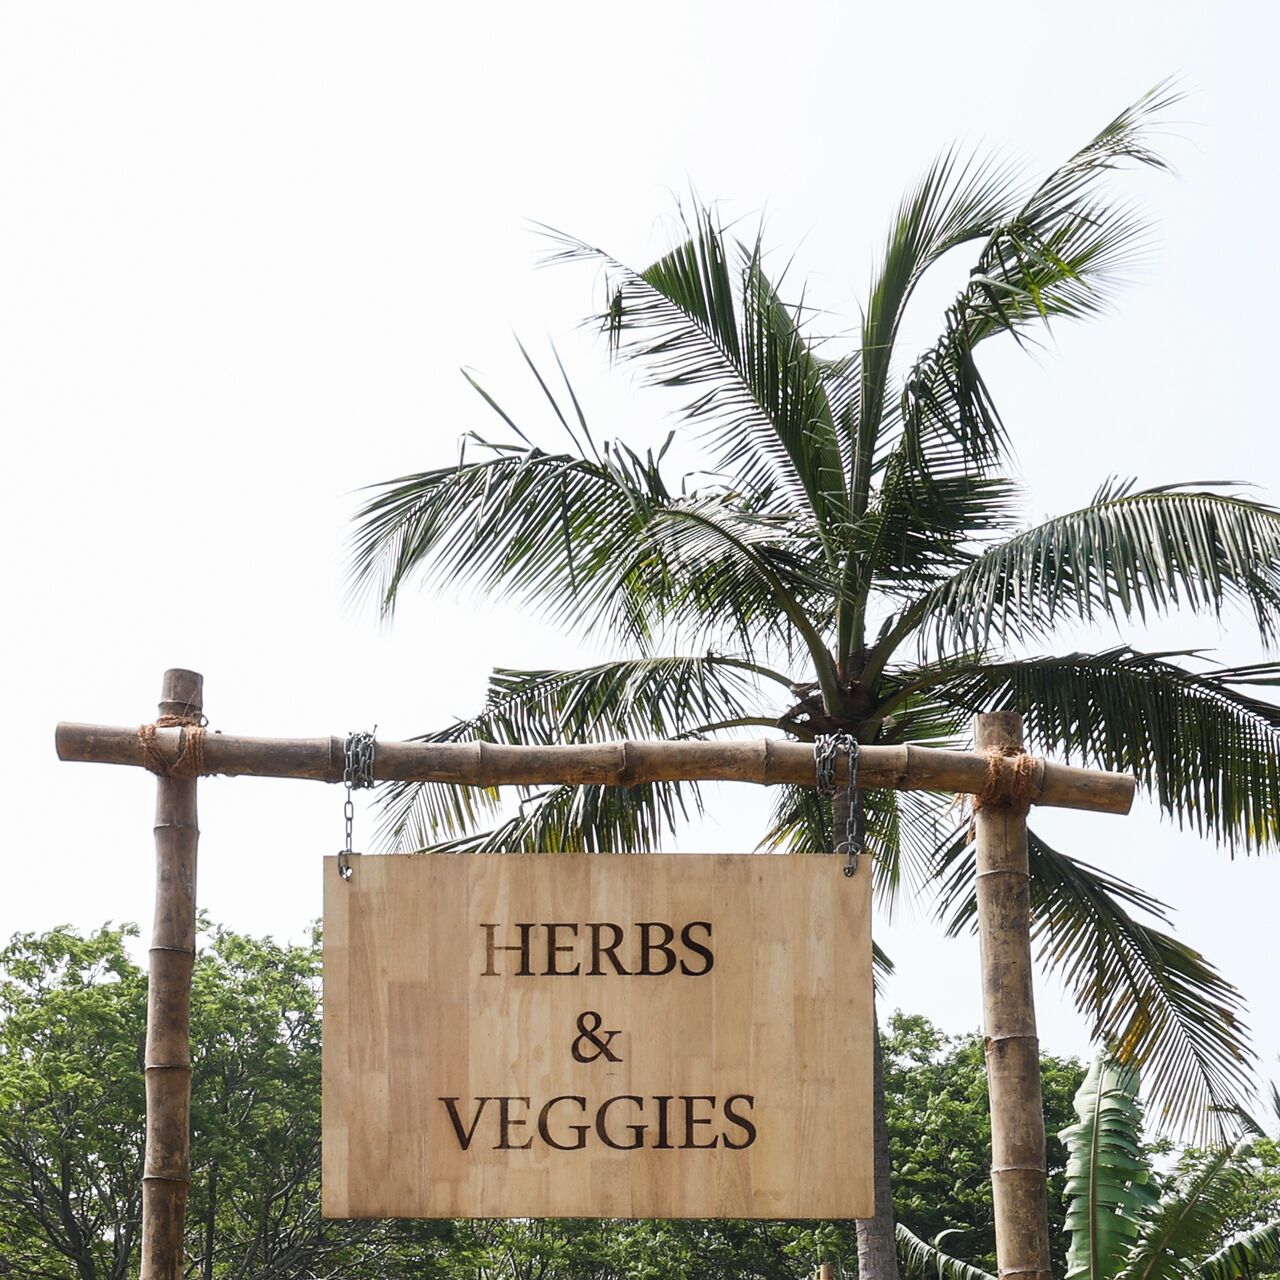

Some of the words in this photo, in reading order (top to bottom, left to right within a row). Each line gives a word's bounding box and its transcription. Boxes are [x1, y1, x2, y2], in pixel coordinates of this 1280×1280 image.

[480, 922, 715, 977] HERBS
[571, 1011, 623, 1063] &
[439, 1094, 757, 1151] VEGGIES
